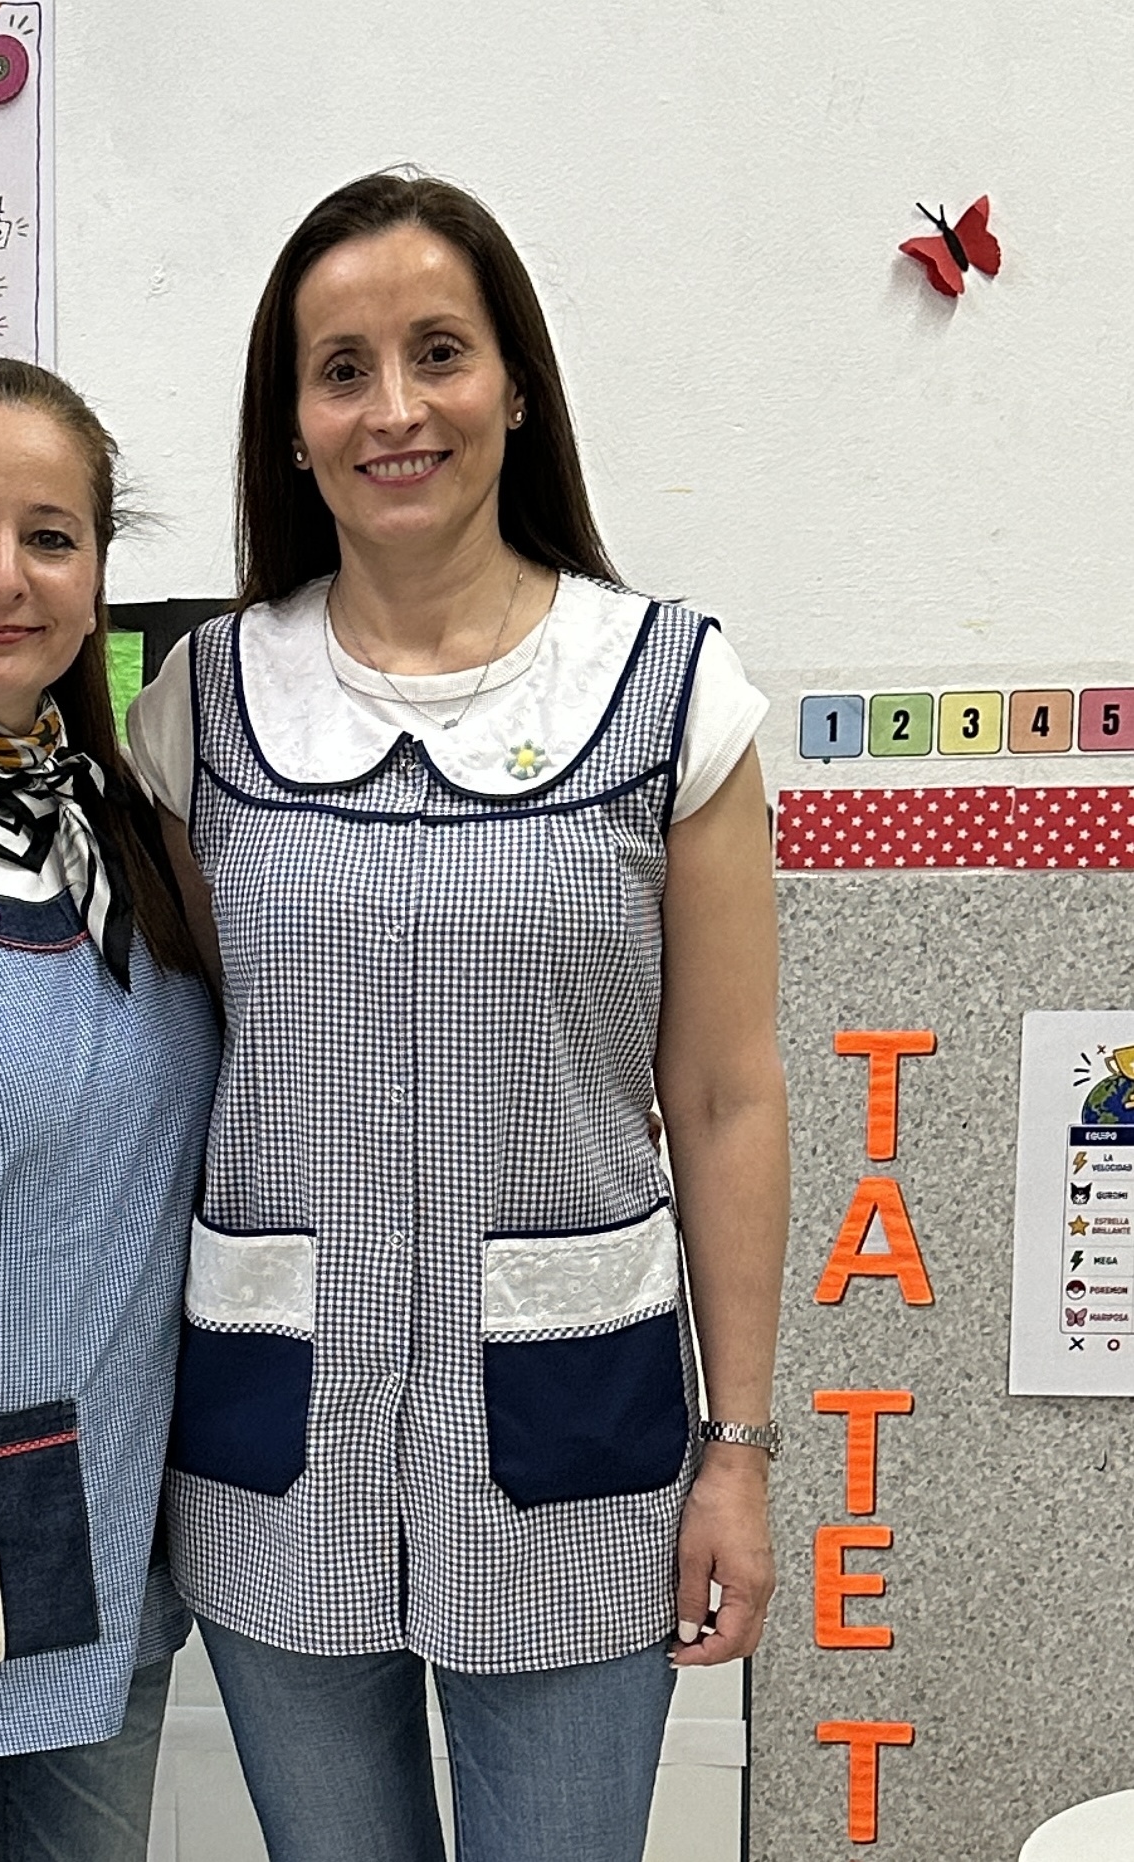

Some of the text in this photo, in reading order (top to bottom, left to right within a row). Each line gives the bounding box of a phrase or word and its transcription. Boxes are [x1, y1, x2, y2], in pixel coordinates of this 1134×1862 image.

[825, 704, 1120, 742] 1 2 3 4 5
[1103, 1154, 1113, 1162] LA
[1094, 1256, 1118, 1265] MEGA
